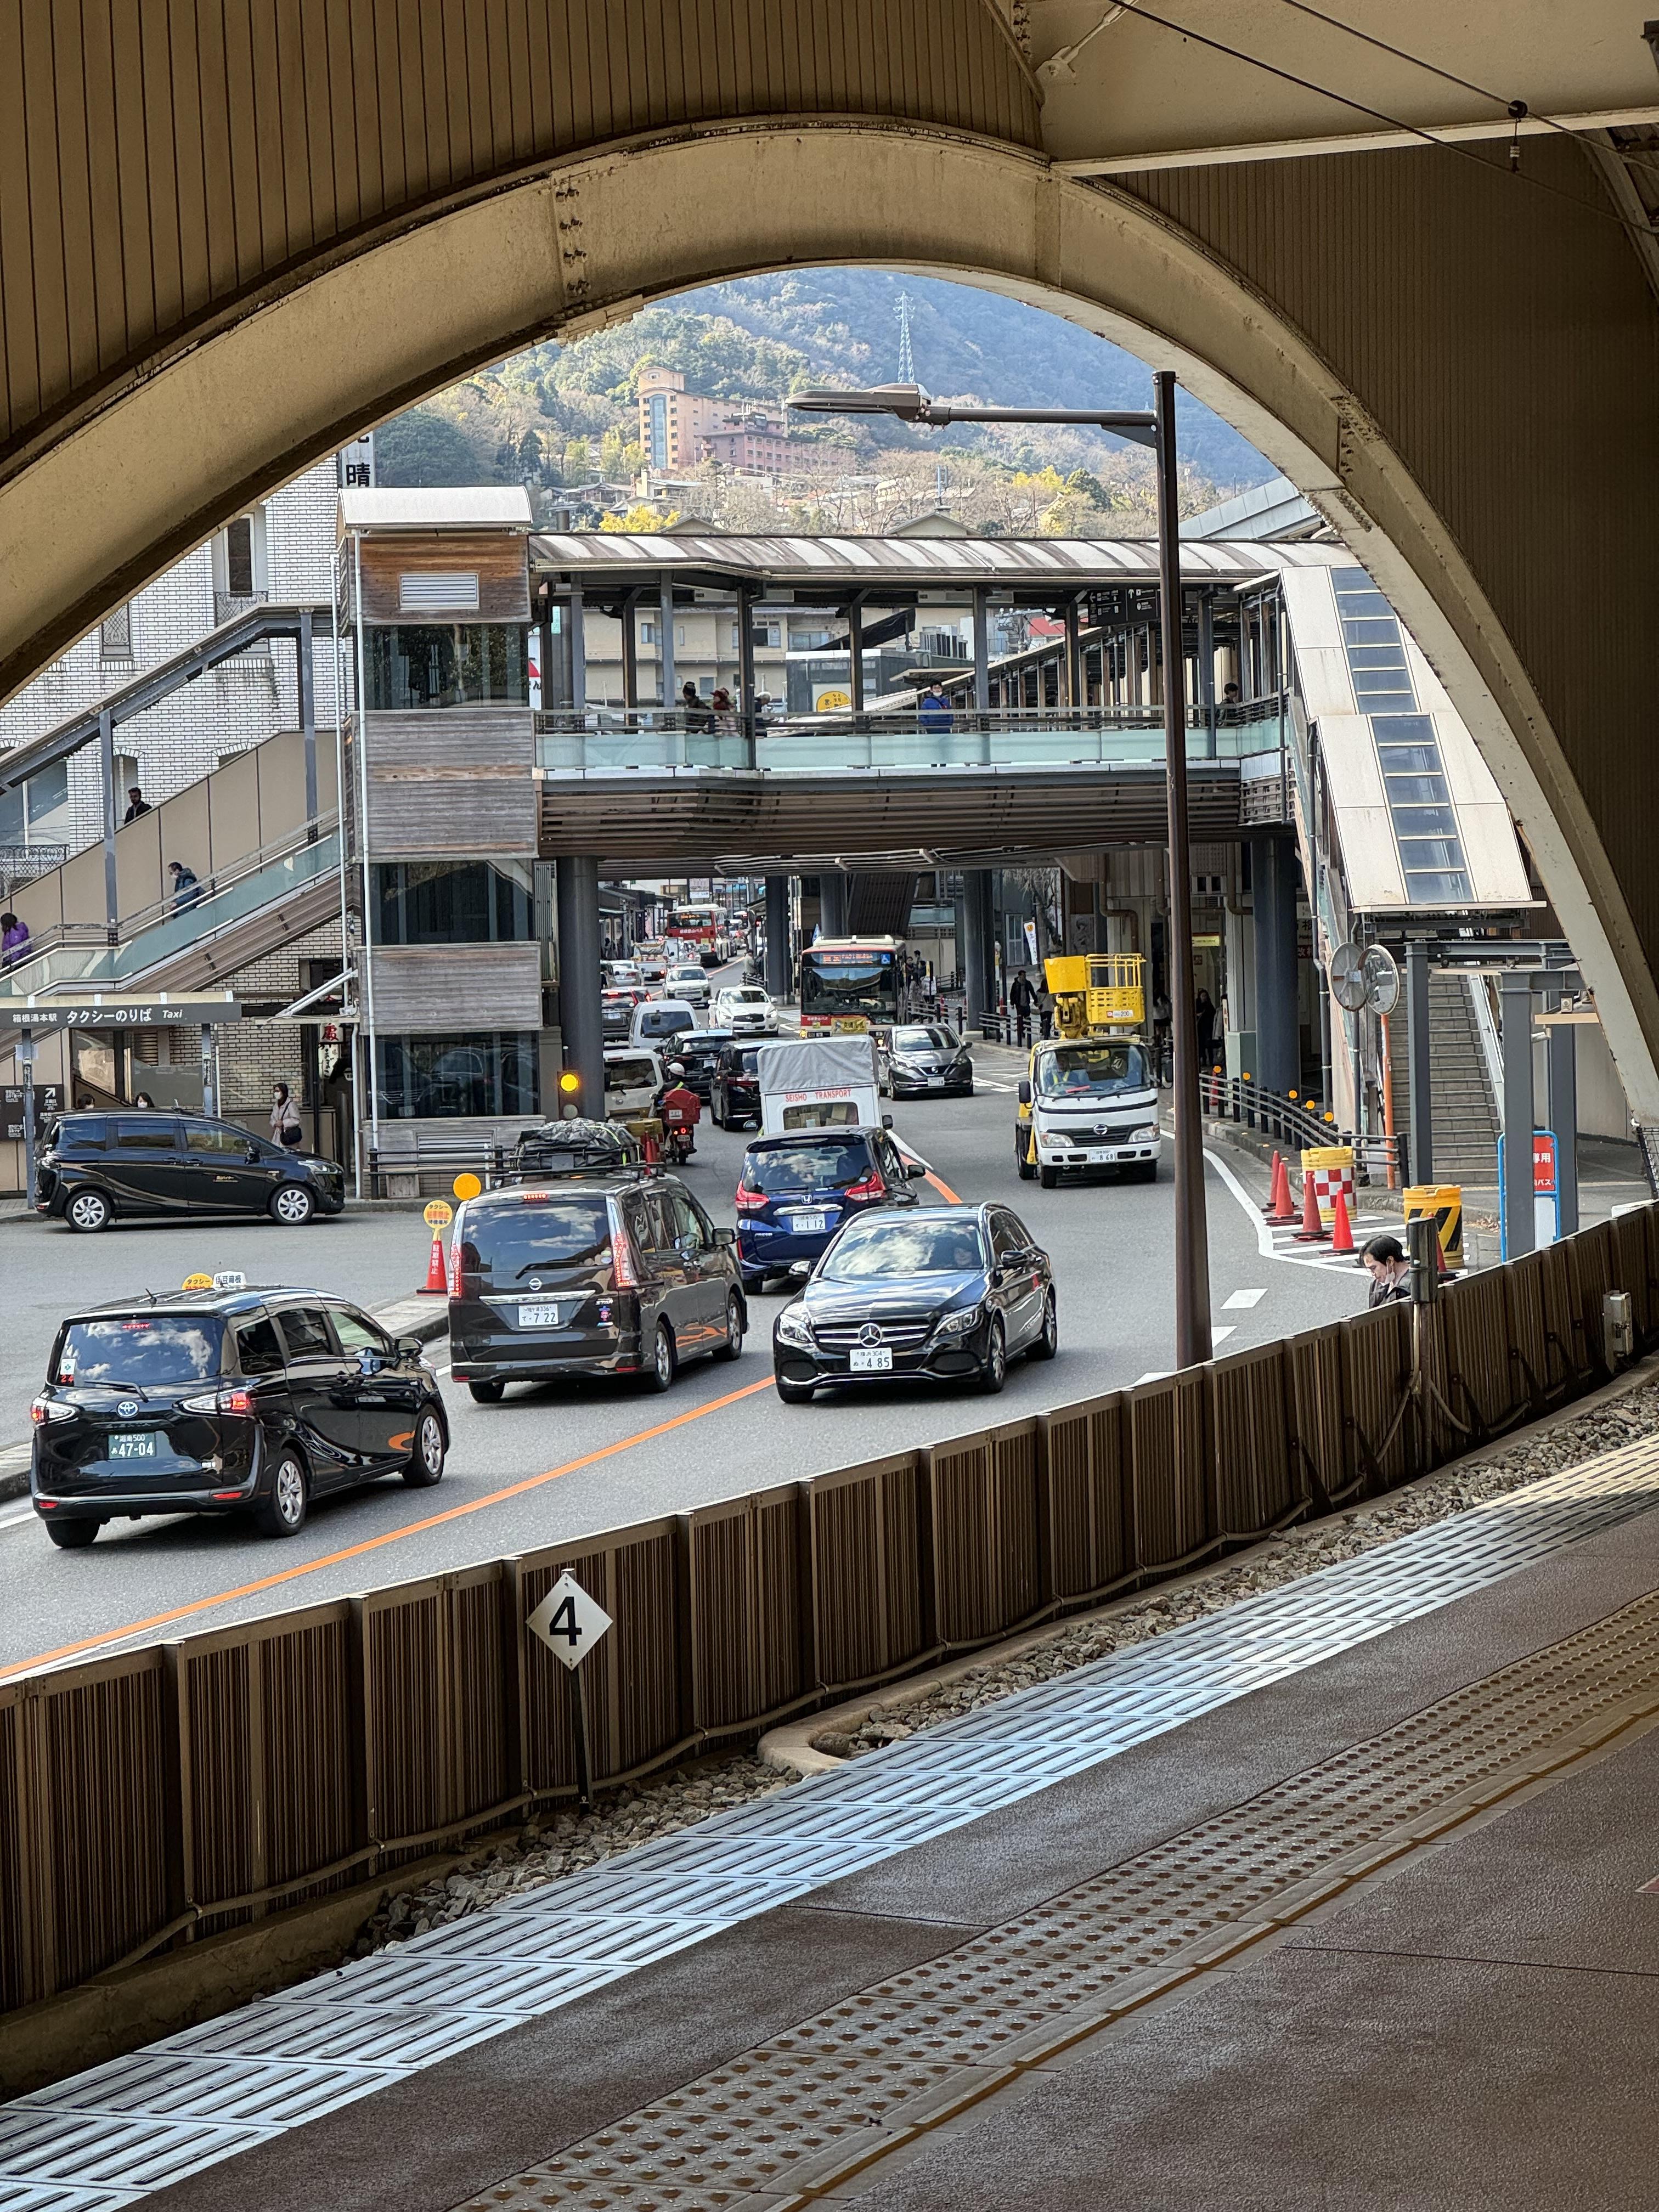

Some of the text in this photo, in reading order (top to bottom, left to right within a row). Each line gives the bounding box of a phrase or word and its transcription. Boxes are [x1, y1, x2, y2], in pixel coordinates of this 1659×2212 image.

[13, 1008, 183, 1024] 箱根湯本駅 タクシーのりば Taxi
[786, 1089, 851, 1102] SEISHO TRANSPORT
[119, 1442, 153, 1457] 47-04
[549, 1596, 582, 1646] 4
